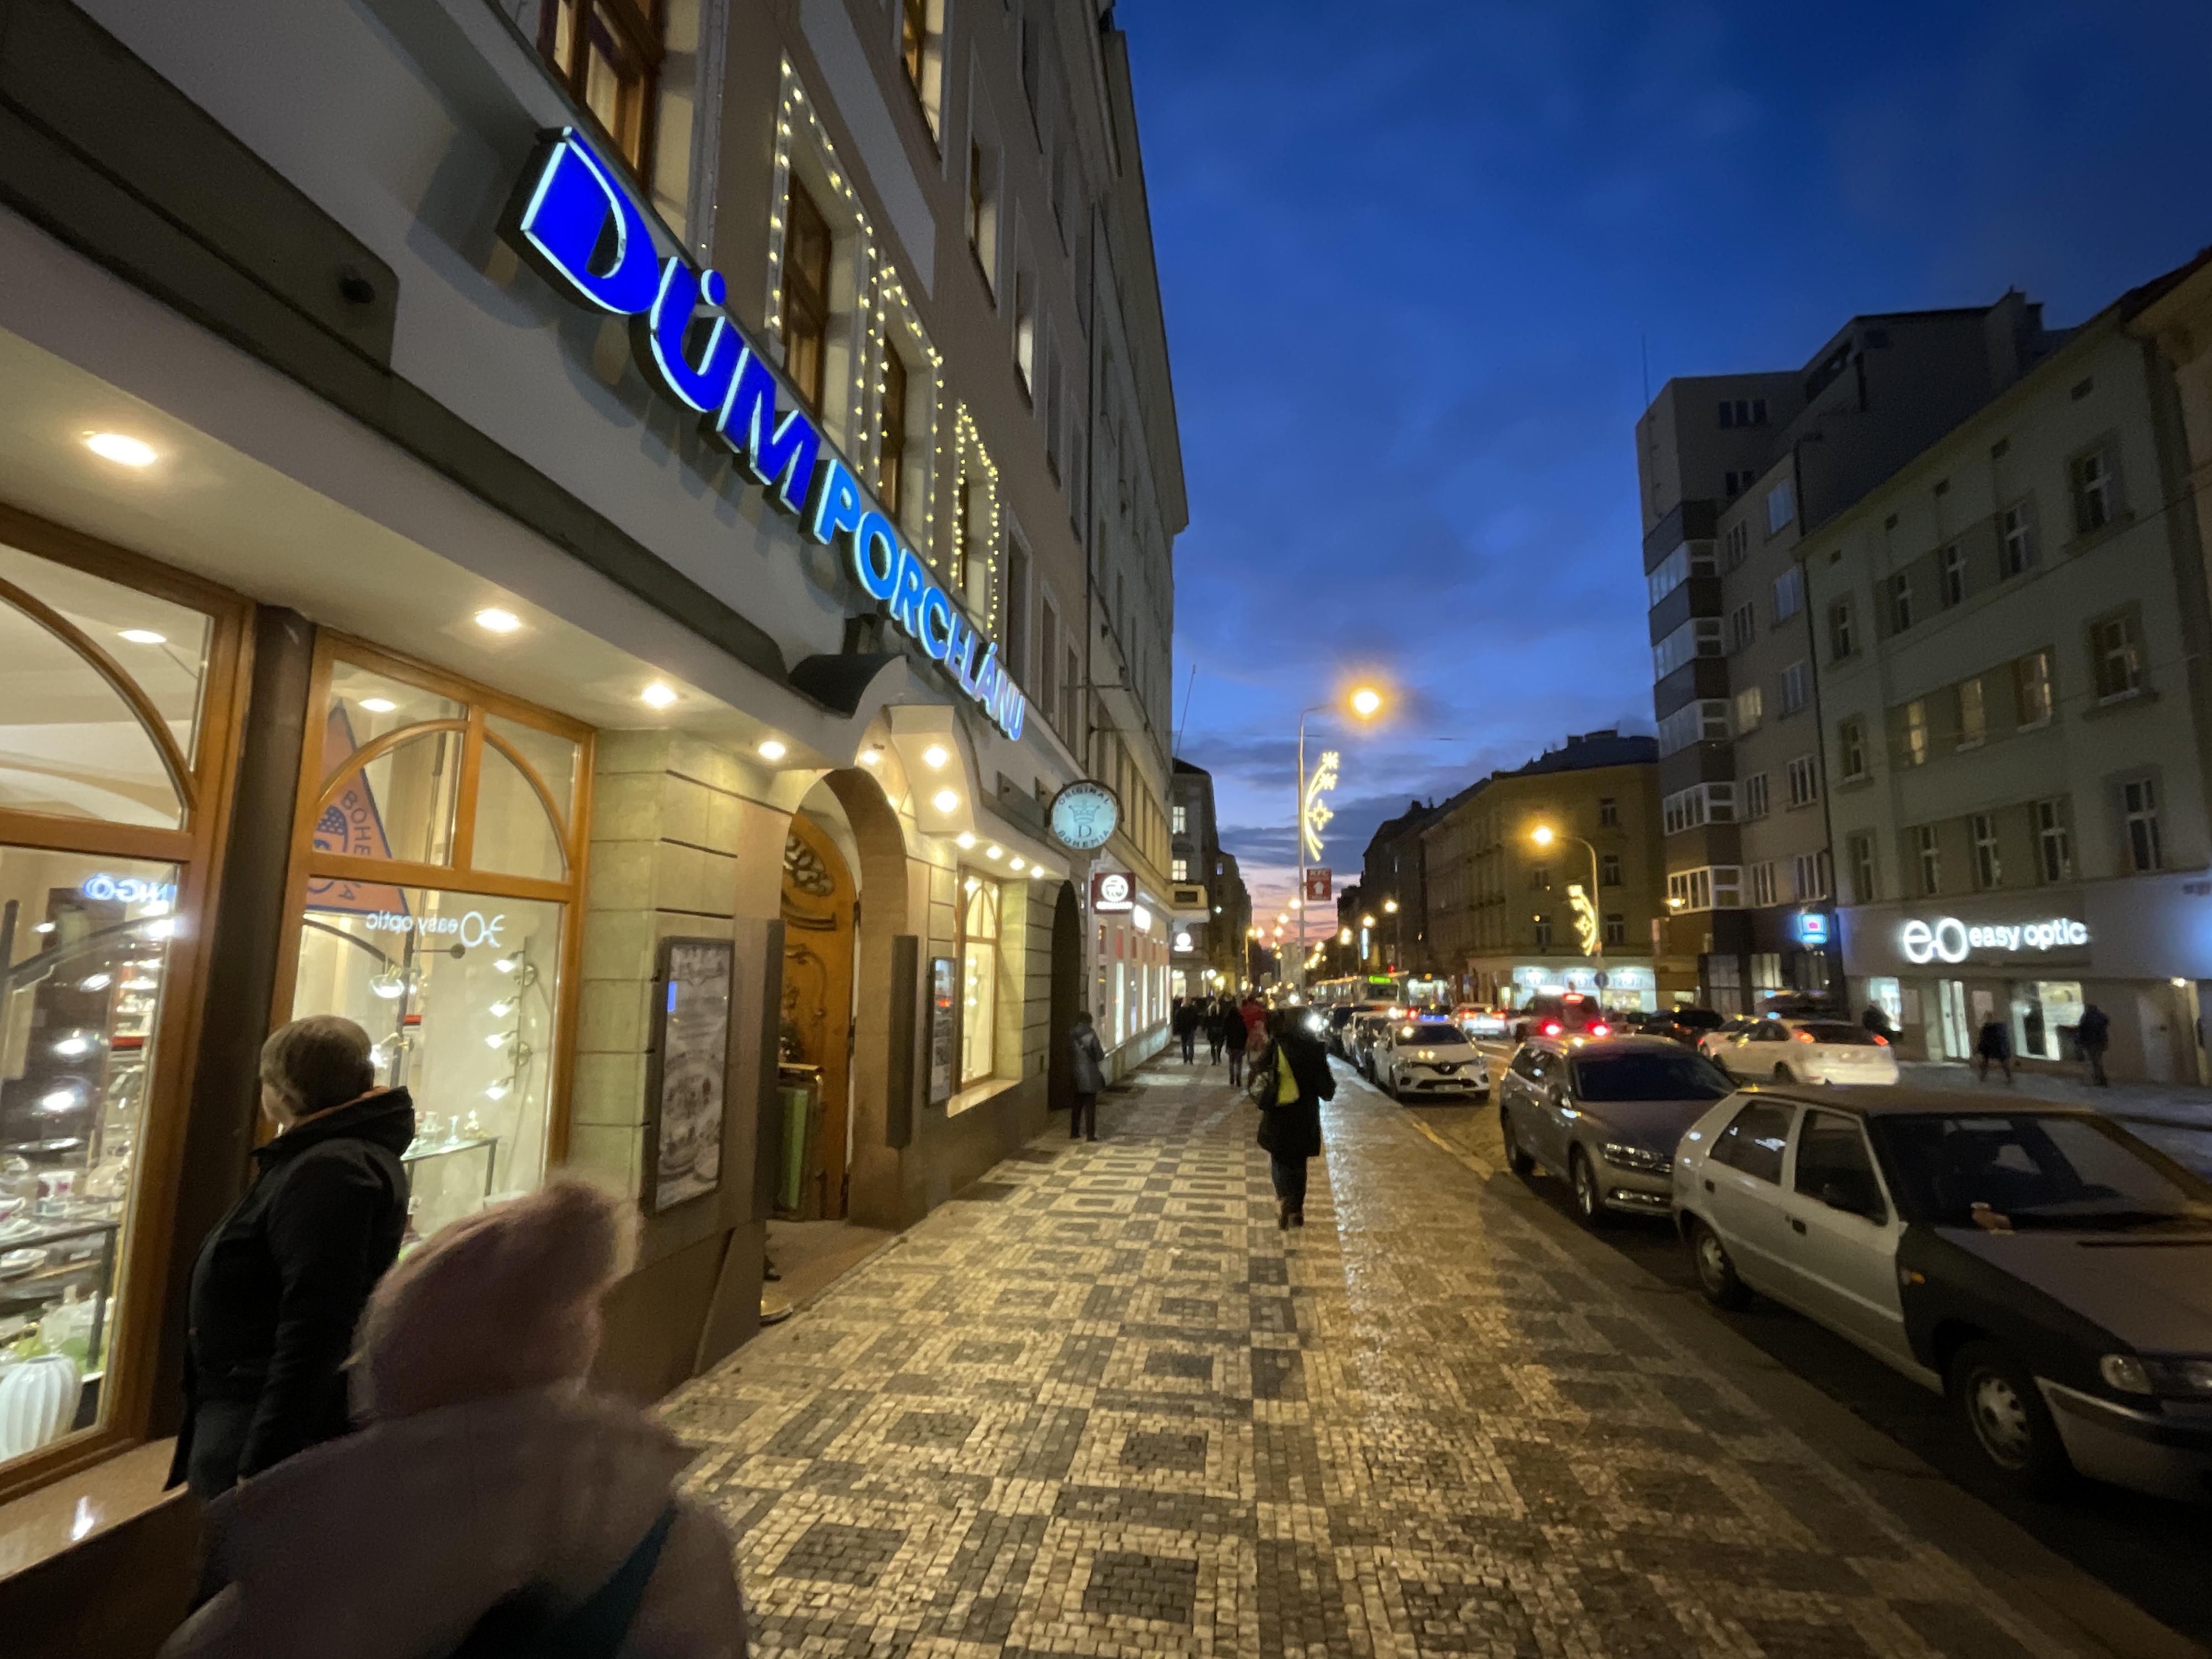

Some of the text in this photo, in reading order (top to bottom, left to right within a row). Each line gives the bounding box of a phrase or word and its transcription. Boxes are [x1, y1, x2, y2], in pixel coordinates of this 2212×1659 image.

[813, 459, 1026, 741] PORCELÁNU
[1058, 786, 1110, 805] ORIGINAL
[1058, 830, 1110, 847] BOHEMIA
[1969, 925, 2021, 951] easy
[2023, 917, 2089, 951] optic
